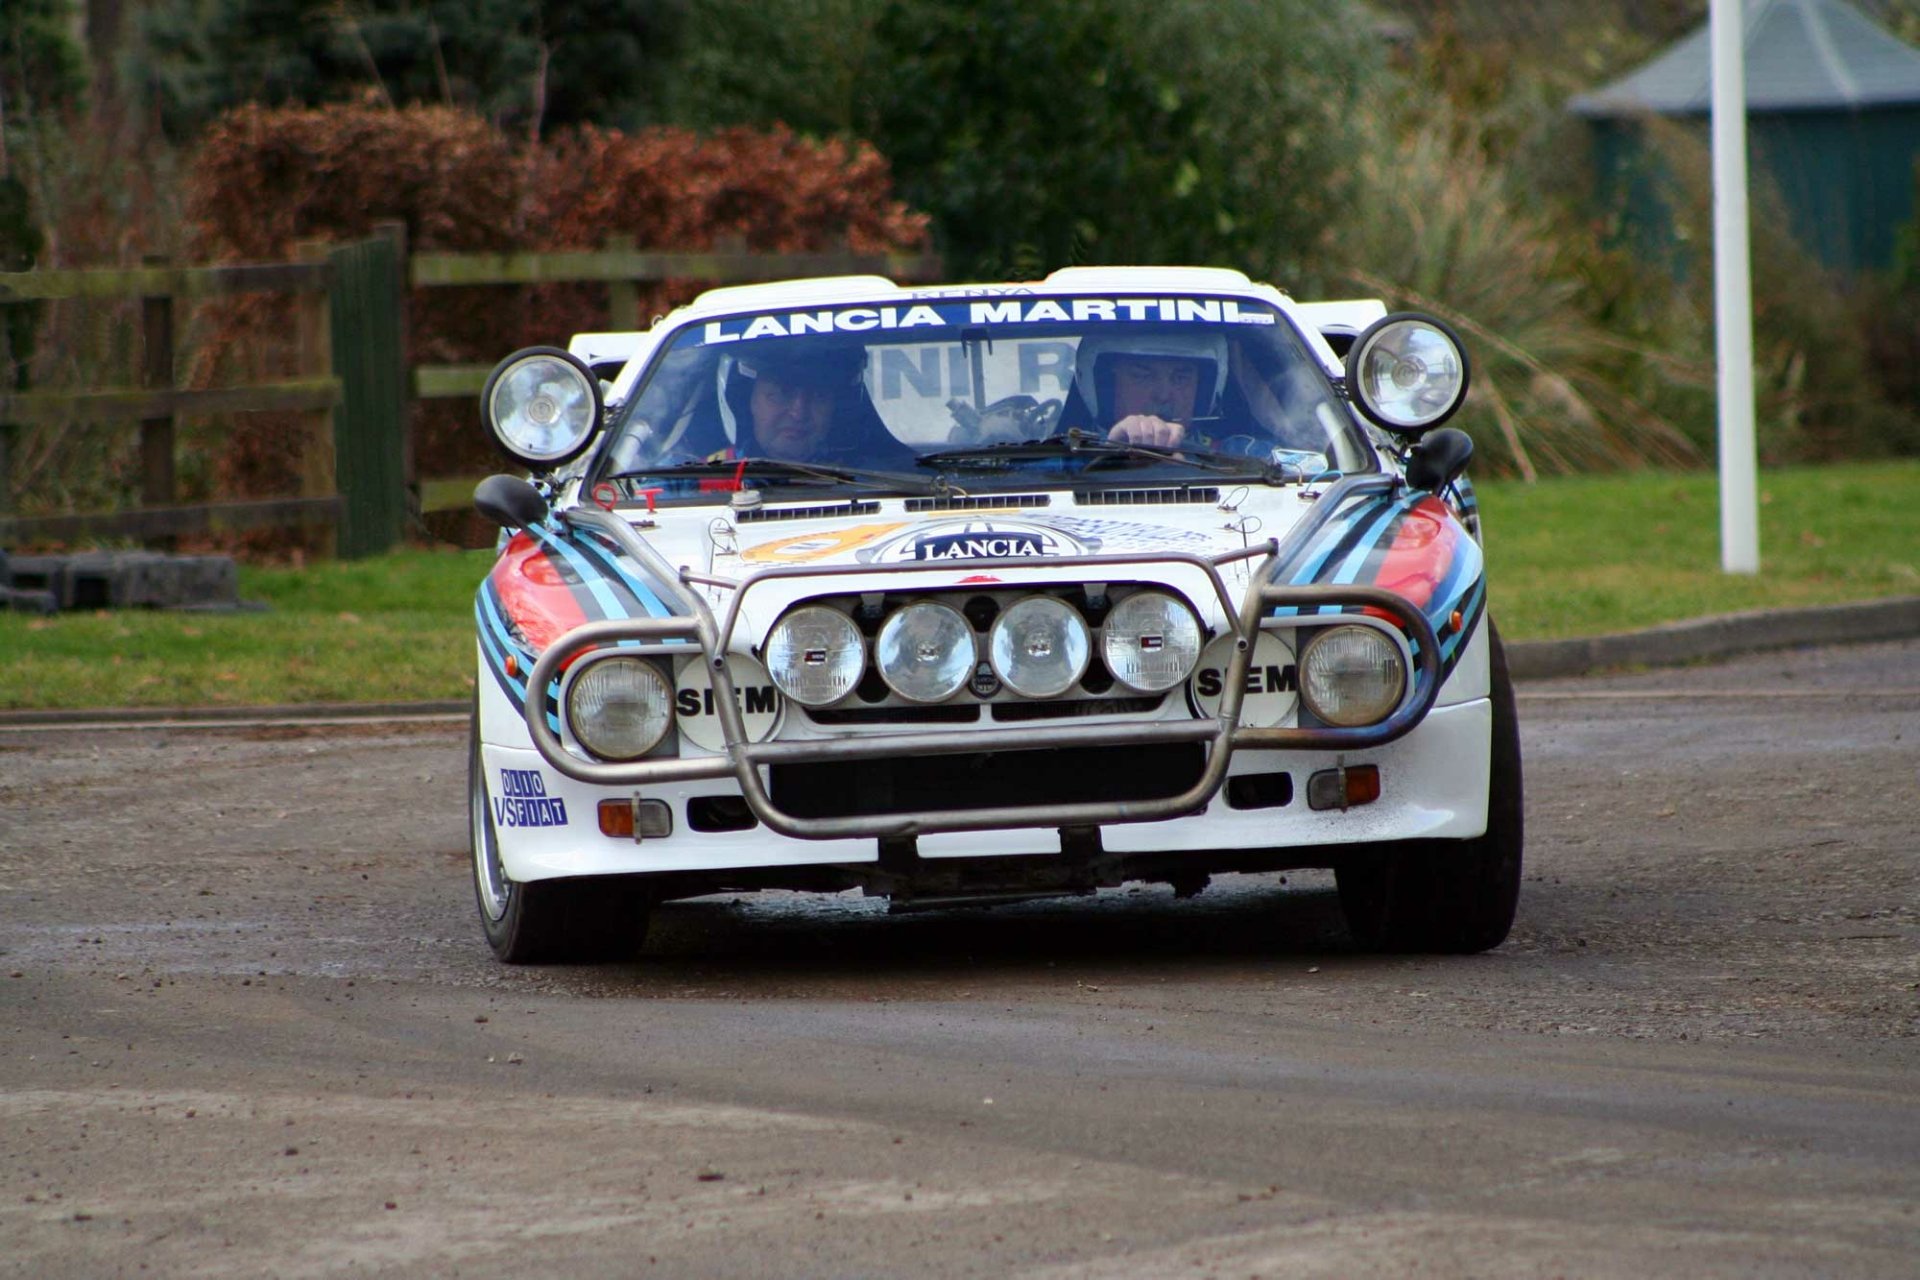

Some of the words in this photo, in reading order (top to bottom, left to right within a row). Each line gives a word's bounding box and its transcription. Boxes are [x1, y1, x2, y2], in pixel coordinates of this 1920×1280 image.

[705, 305, 946, 344] LANCIA
[970, 299, 1239, 324] MARTINI
[924, 539, 1042, 561] LANCIA
[1197, 664, 1297, 697] SEM
[676, 686, 775, 717] SIM
[502, 771, 544, 795] OLIO
